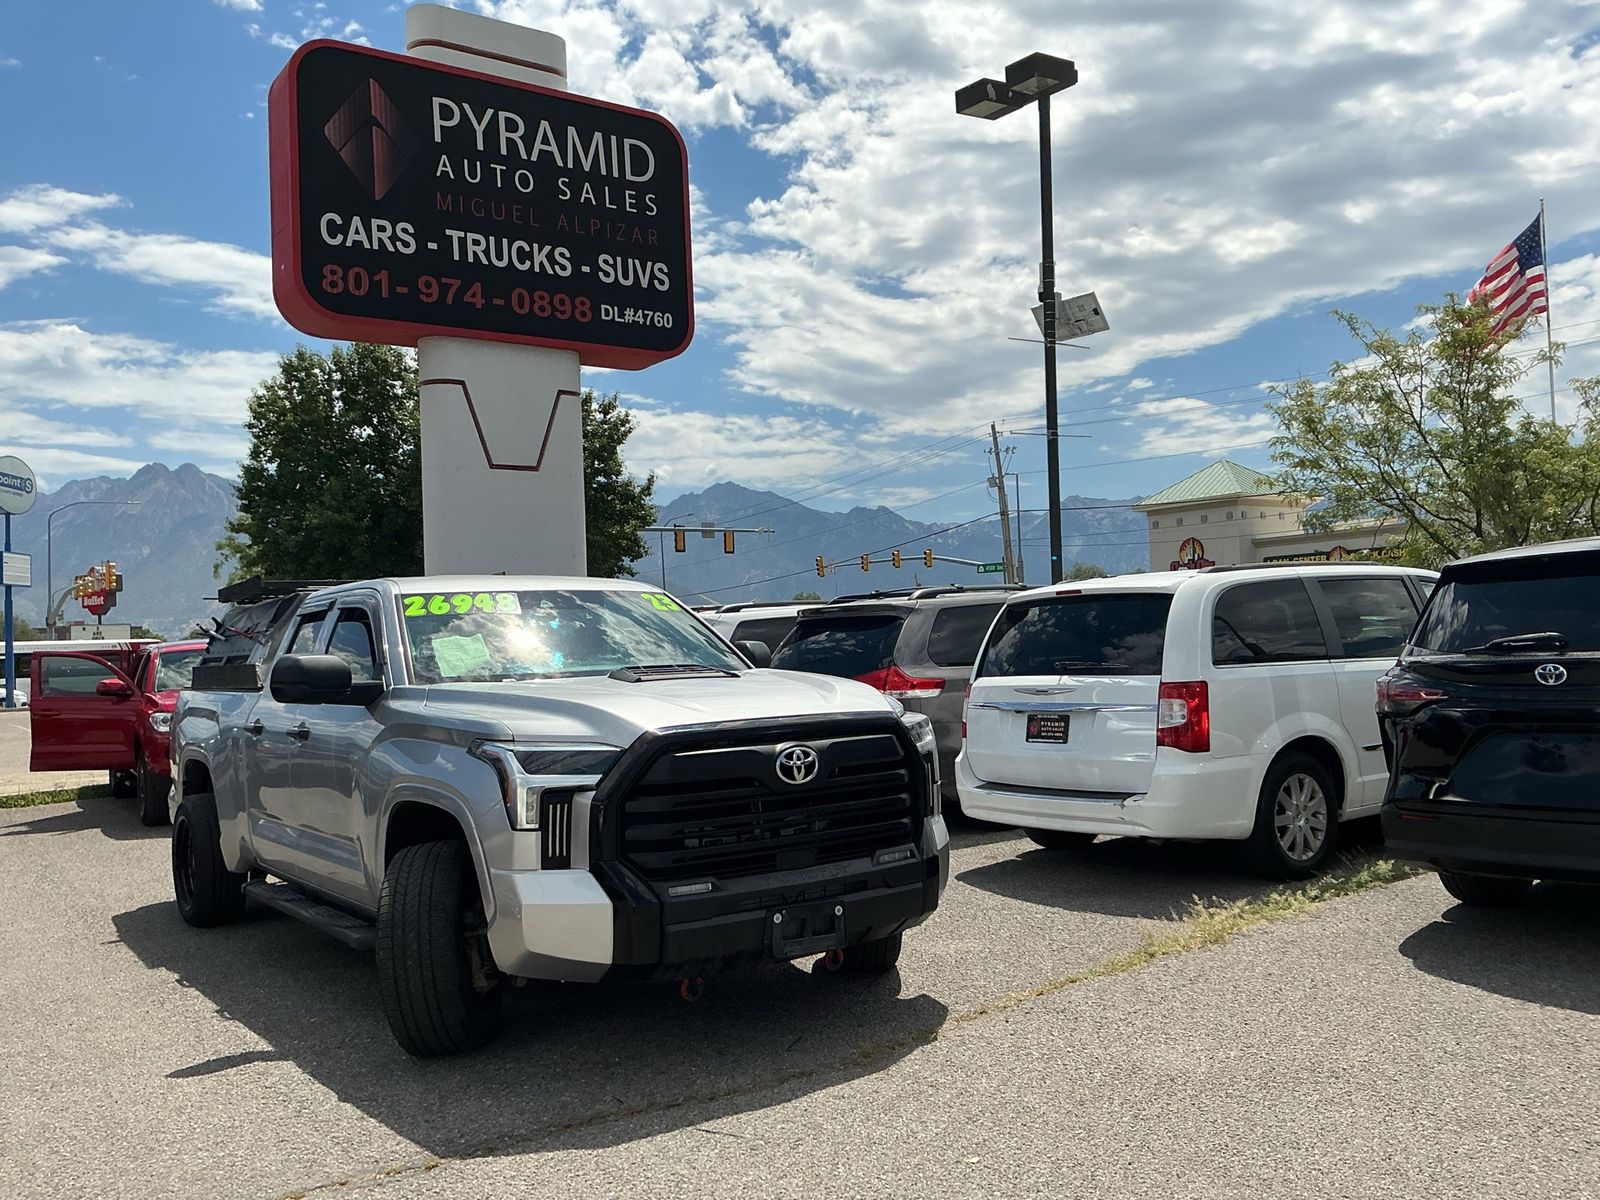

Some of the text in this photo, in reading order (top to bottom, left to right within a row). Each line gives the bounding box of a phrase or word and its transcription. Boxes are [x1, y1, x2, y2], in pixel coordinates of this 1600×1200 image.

[432, 97, 655, 183] PYRAMID
[436, 154, 658, 216] AUTO SALES
[437, 192, 658, 246] MIGUEL ALPIZAR
[320, 212, 670, 292] CARS - TRUCKS - SUVS
[321, 264, 673, 329] 801-974-0898 DL#4760
[83, 595, 105, 606] Buffet
